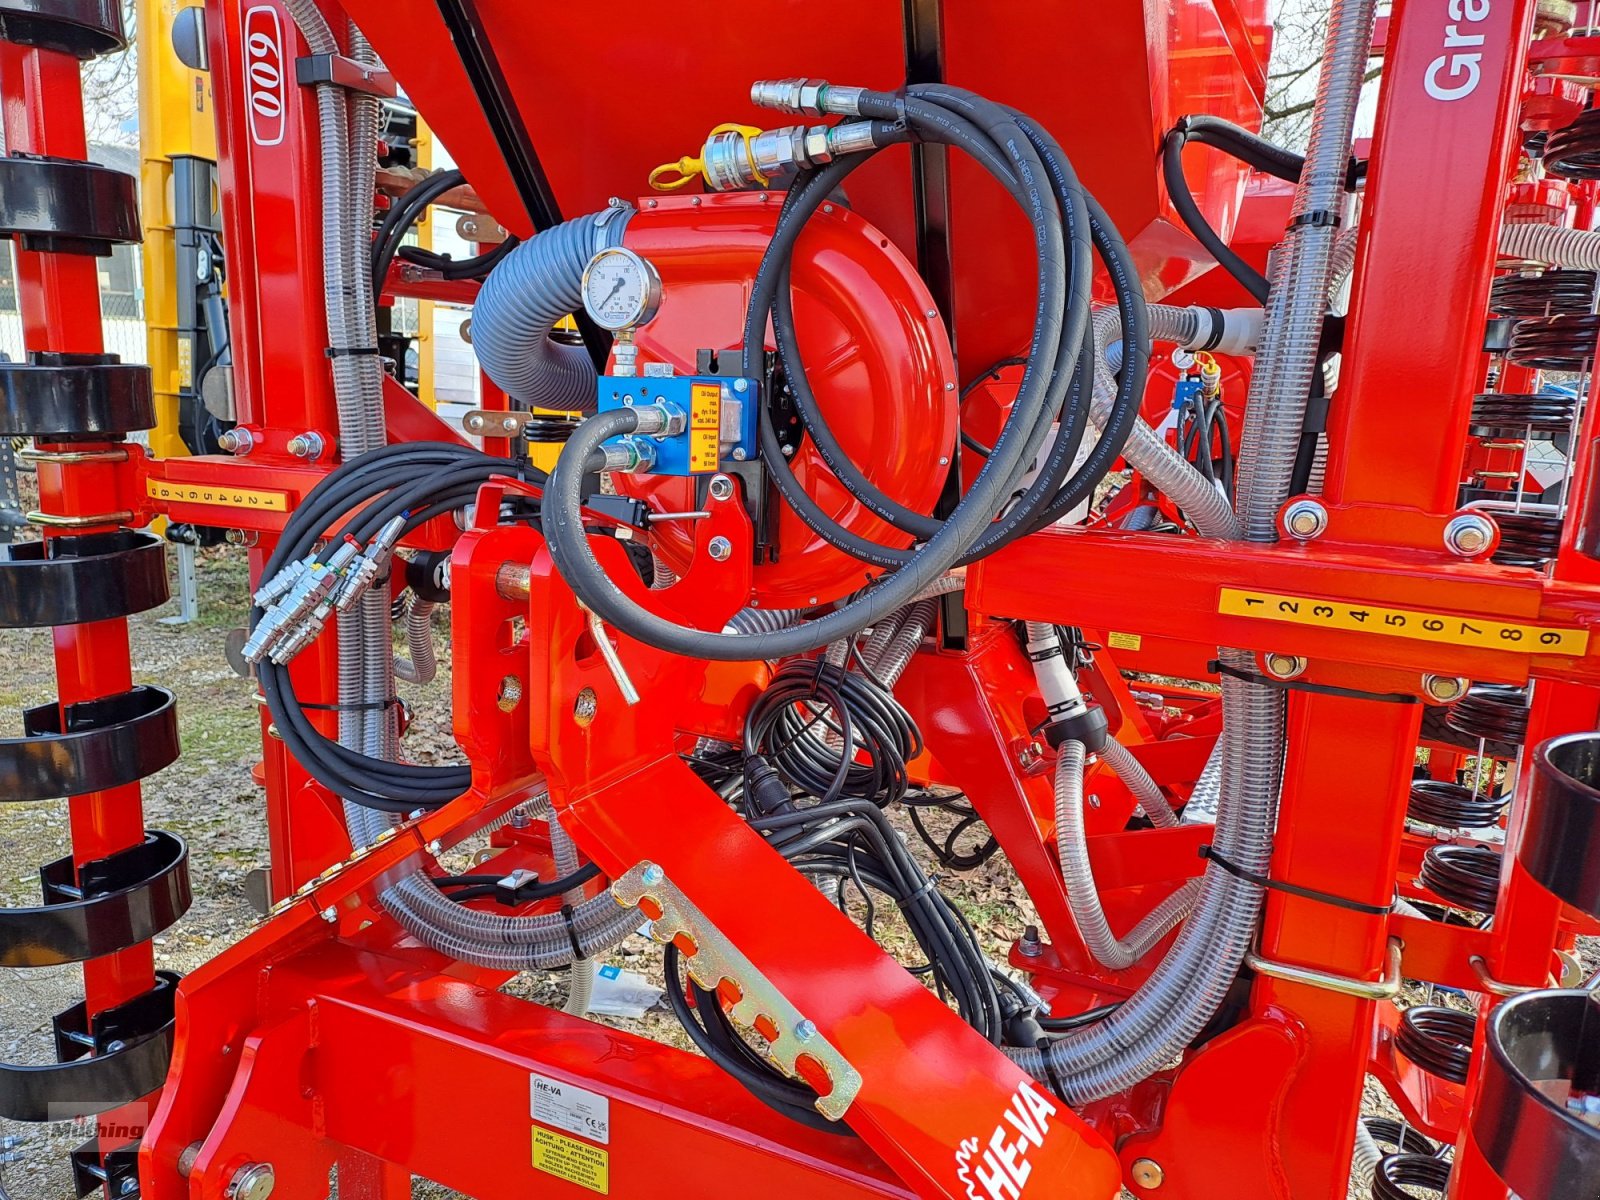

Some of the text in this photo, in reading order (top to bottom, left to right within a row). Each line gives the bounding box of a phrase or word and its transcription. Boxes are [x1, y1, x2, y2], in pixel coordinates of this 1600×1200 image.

[249, 32, 280, 117] 600
[1016, 159, 1035, 185] ENERGY
[1028, 188, 1043, 221] COMPACT
[1037, 225, 1046, 246] EC28
[1246, 598, 1562, 645] 1 2 3 4 5 6 7 8 9
[536, 1082, 561, 1096] HE-VA
[535, 1138, 564, 1152] ACHTUNG
[570, 1151, 605, 1167] ATTENTION
[537, 1131, 554, 1141] HUSK
[560, 1139, 583, 1151] PLEASE
[585, 1149, 602, 1158] NOTE
[974, 1080, 1056, 1200] HE-VA
